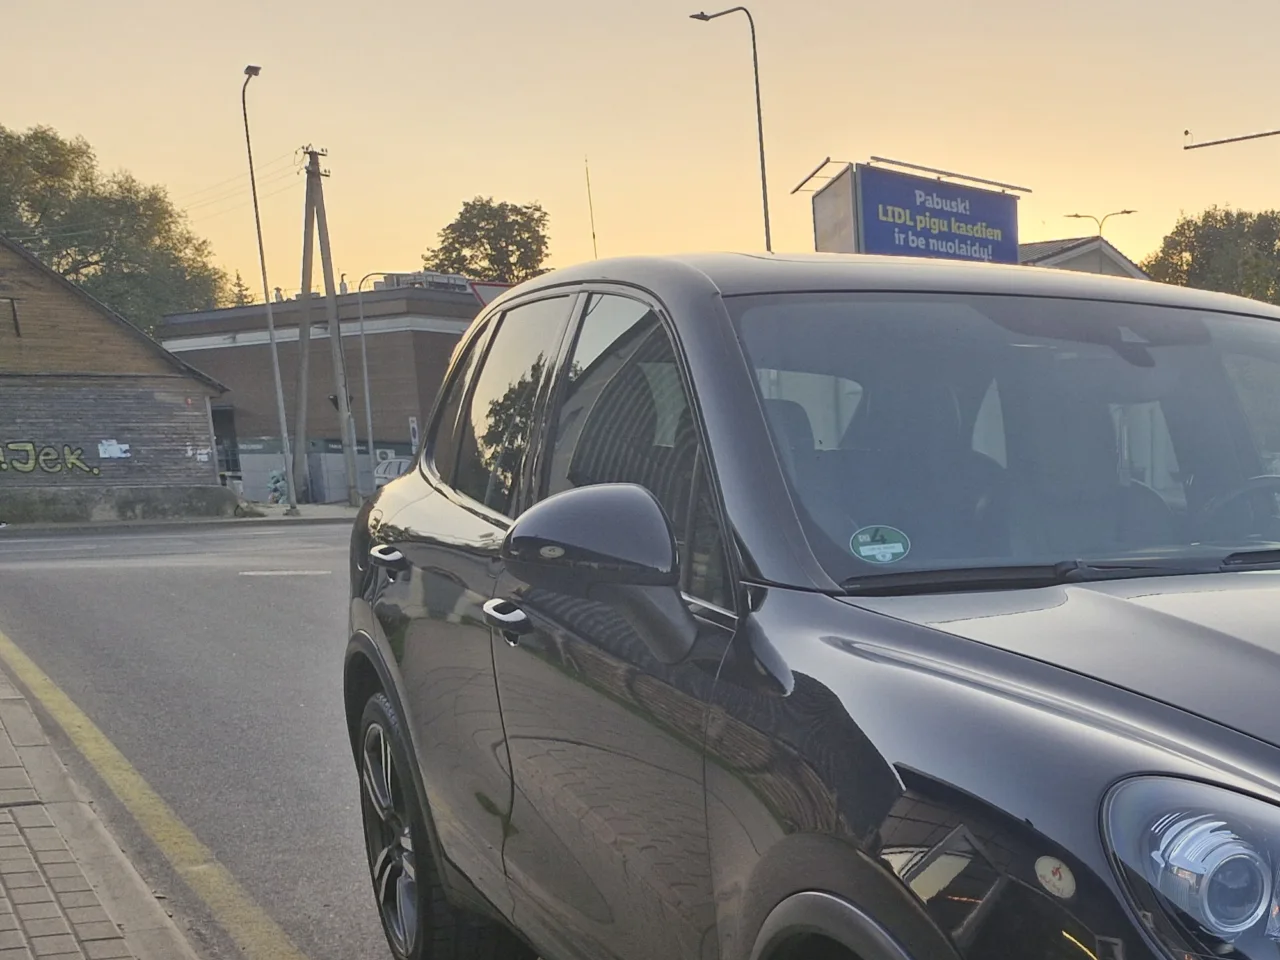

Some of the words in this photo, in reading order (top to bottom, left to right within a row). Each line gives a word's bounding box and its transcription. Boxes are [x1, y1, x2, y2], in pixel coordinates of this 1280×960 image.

[915, 190, 970, 215] Pabusk!
[878, 204, 914, 226] LIDL
[916, 214, 949, 233] pigu
[951, 217, 1002, 241] kasdien
[894, 228, 905, 245] ir
[908, 231, 926, 249] be
[929, 239, 993, 261] nuolaidy!
